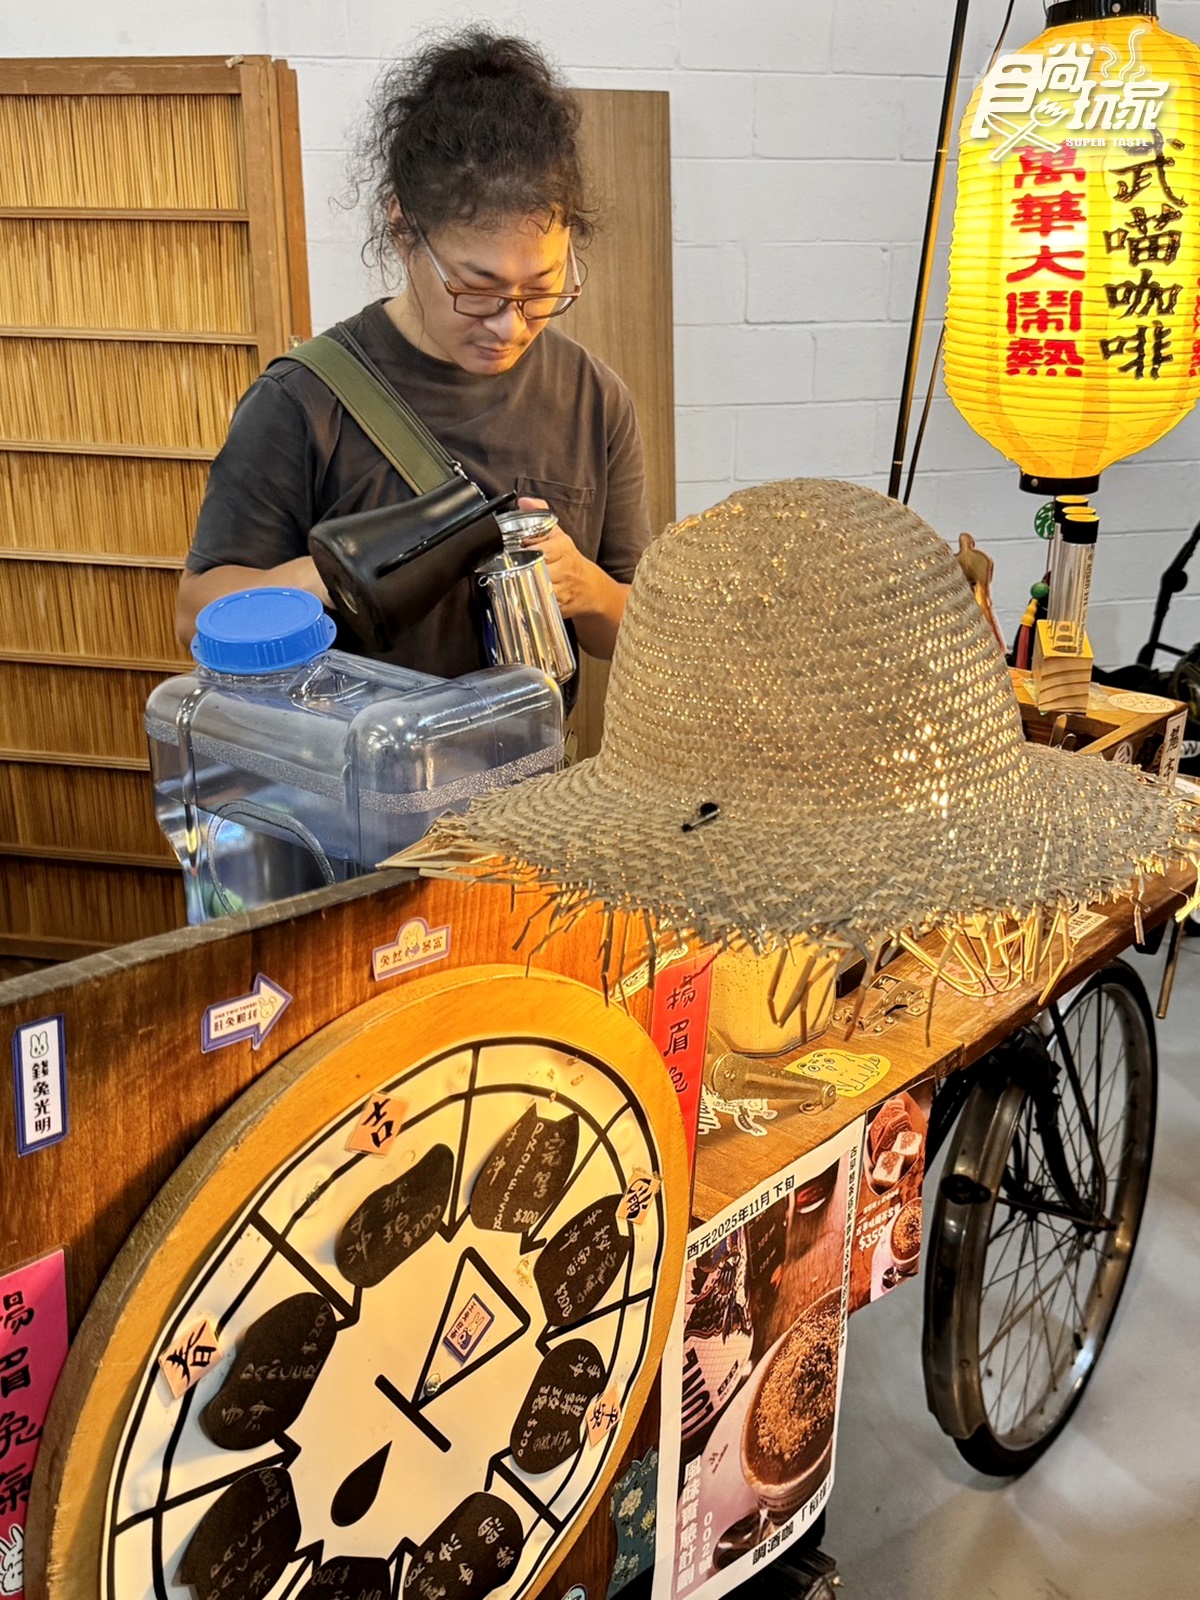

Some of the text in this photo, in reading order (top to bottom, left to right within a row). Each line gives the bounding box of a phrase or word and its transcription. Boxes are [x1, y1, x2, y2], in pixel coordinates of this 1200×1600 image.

[1006, 146, 1087, 377] 萬華大鬧熱
[1101, 127, 1188, 380] 武喵咖啡
[31, 1060, 52, 1134] 錢兔光明
[361, 1098, 394, 1148] 吉
[401, 1204, 442, 1248] $200
[513, 1207, 539, 1224] $200
[687, 1191, 771, 1258] 西元2025年11月
[773, 1174, 796, 1199] 下旬
